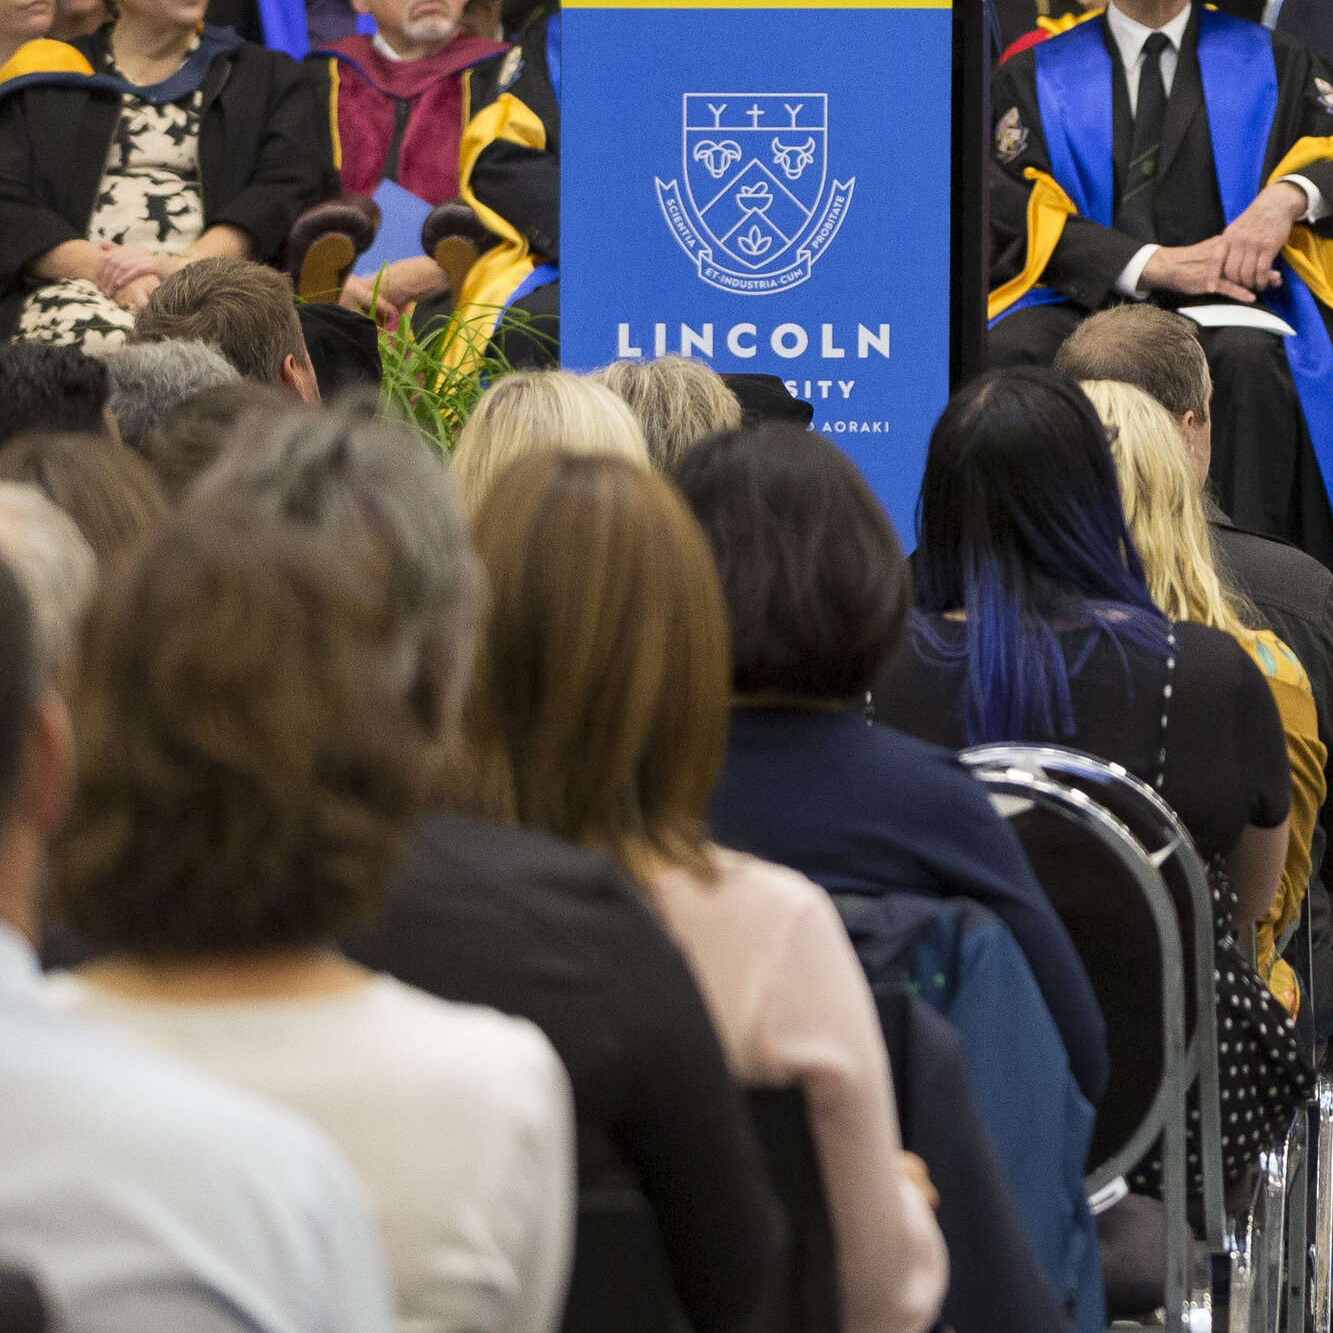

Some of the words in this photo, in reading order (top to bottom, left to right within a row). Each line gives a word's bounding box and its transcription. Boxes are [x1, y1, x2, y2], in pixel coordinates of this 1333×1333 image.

[666, 198, 696, 248] SCIENTIA
[811, 195, 845, 250] PROBITATE
[618, 322, 891, 359] LINCOLN
[821, 420, 890, 433] AORAKI
